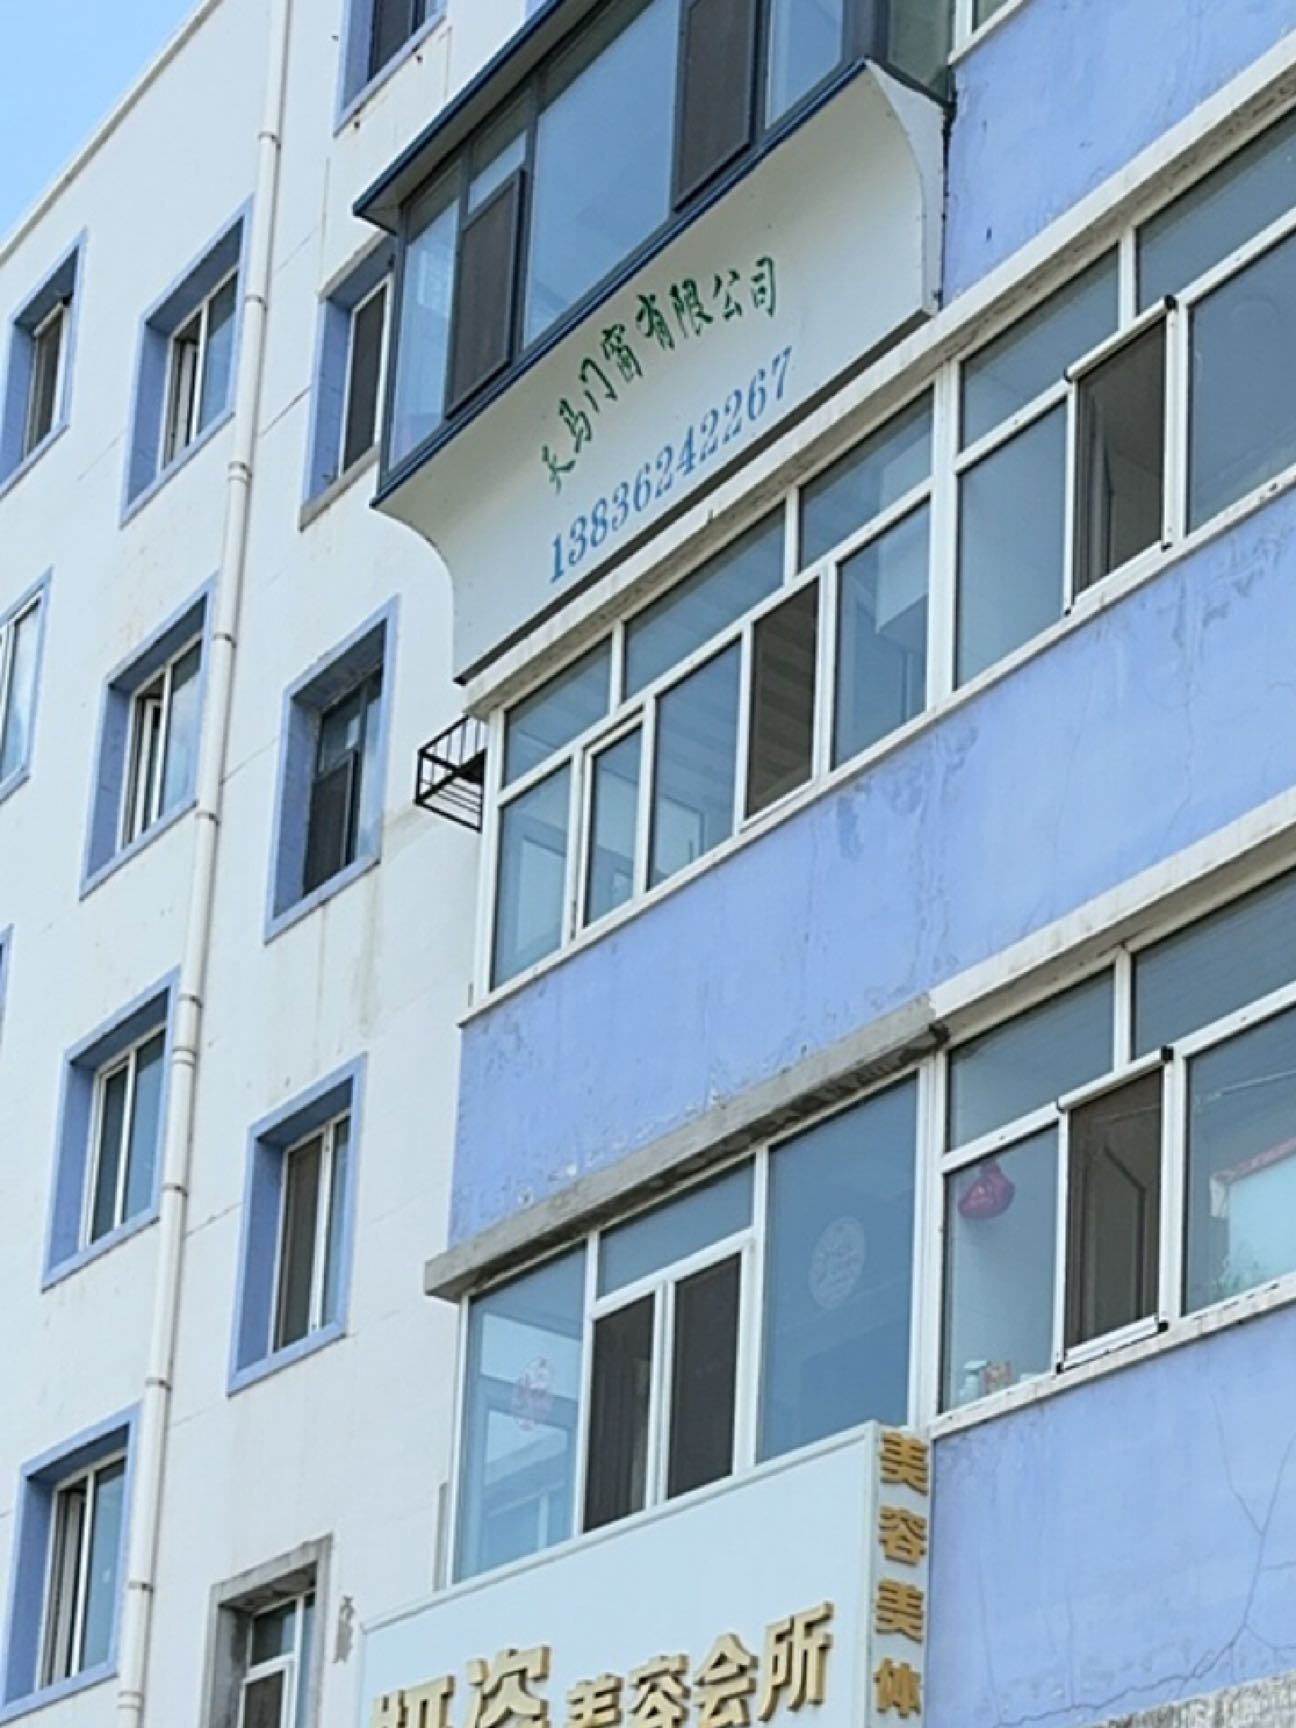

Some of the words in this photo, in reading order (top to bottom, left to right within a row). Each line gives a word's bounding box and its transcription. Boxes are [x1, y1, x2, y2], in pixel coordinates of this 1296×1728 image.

[548, 346, 793, 583] 13836242267
[873, 1431, 929, 1719] 美容美体
